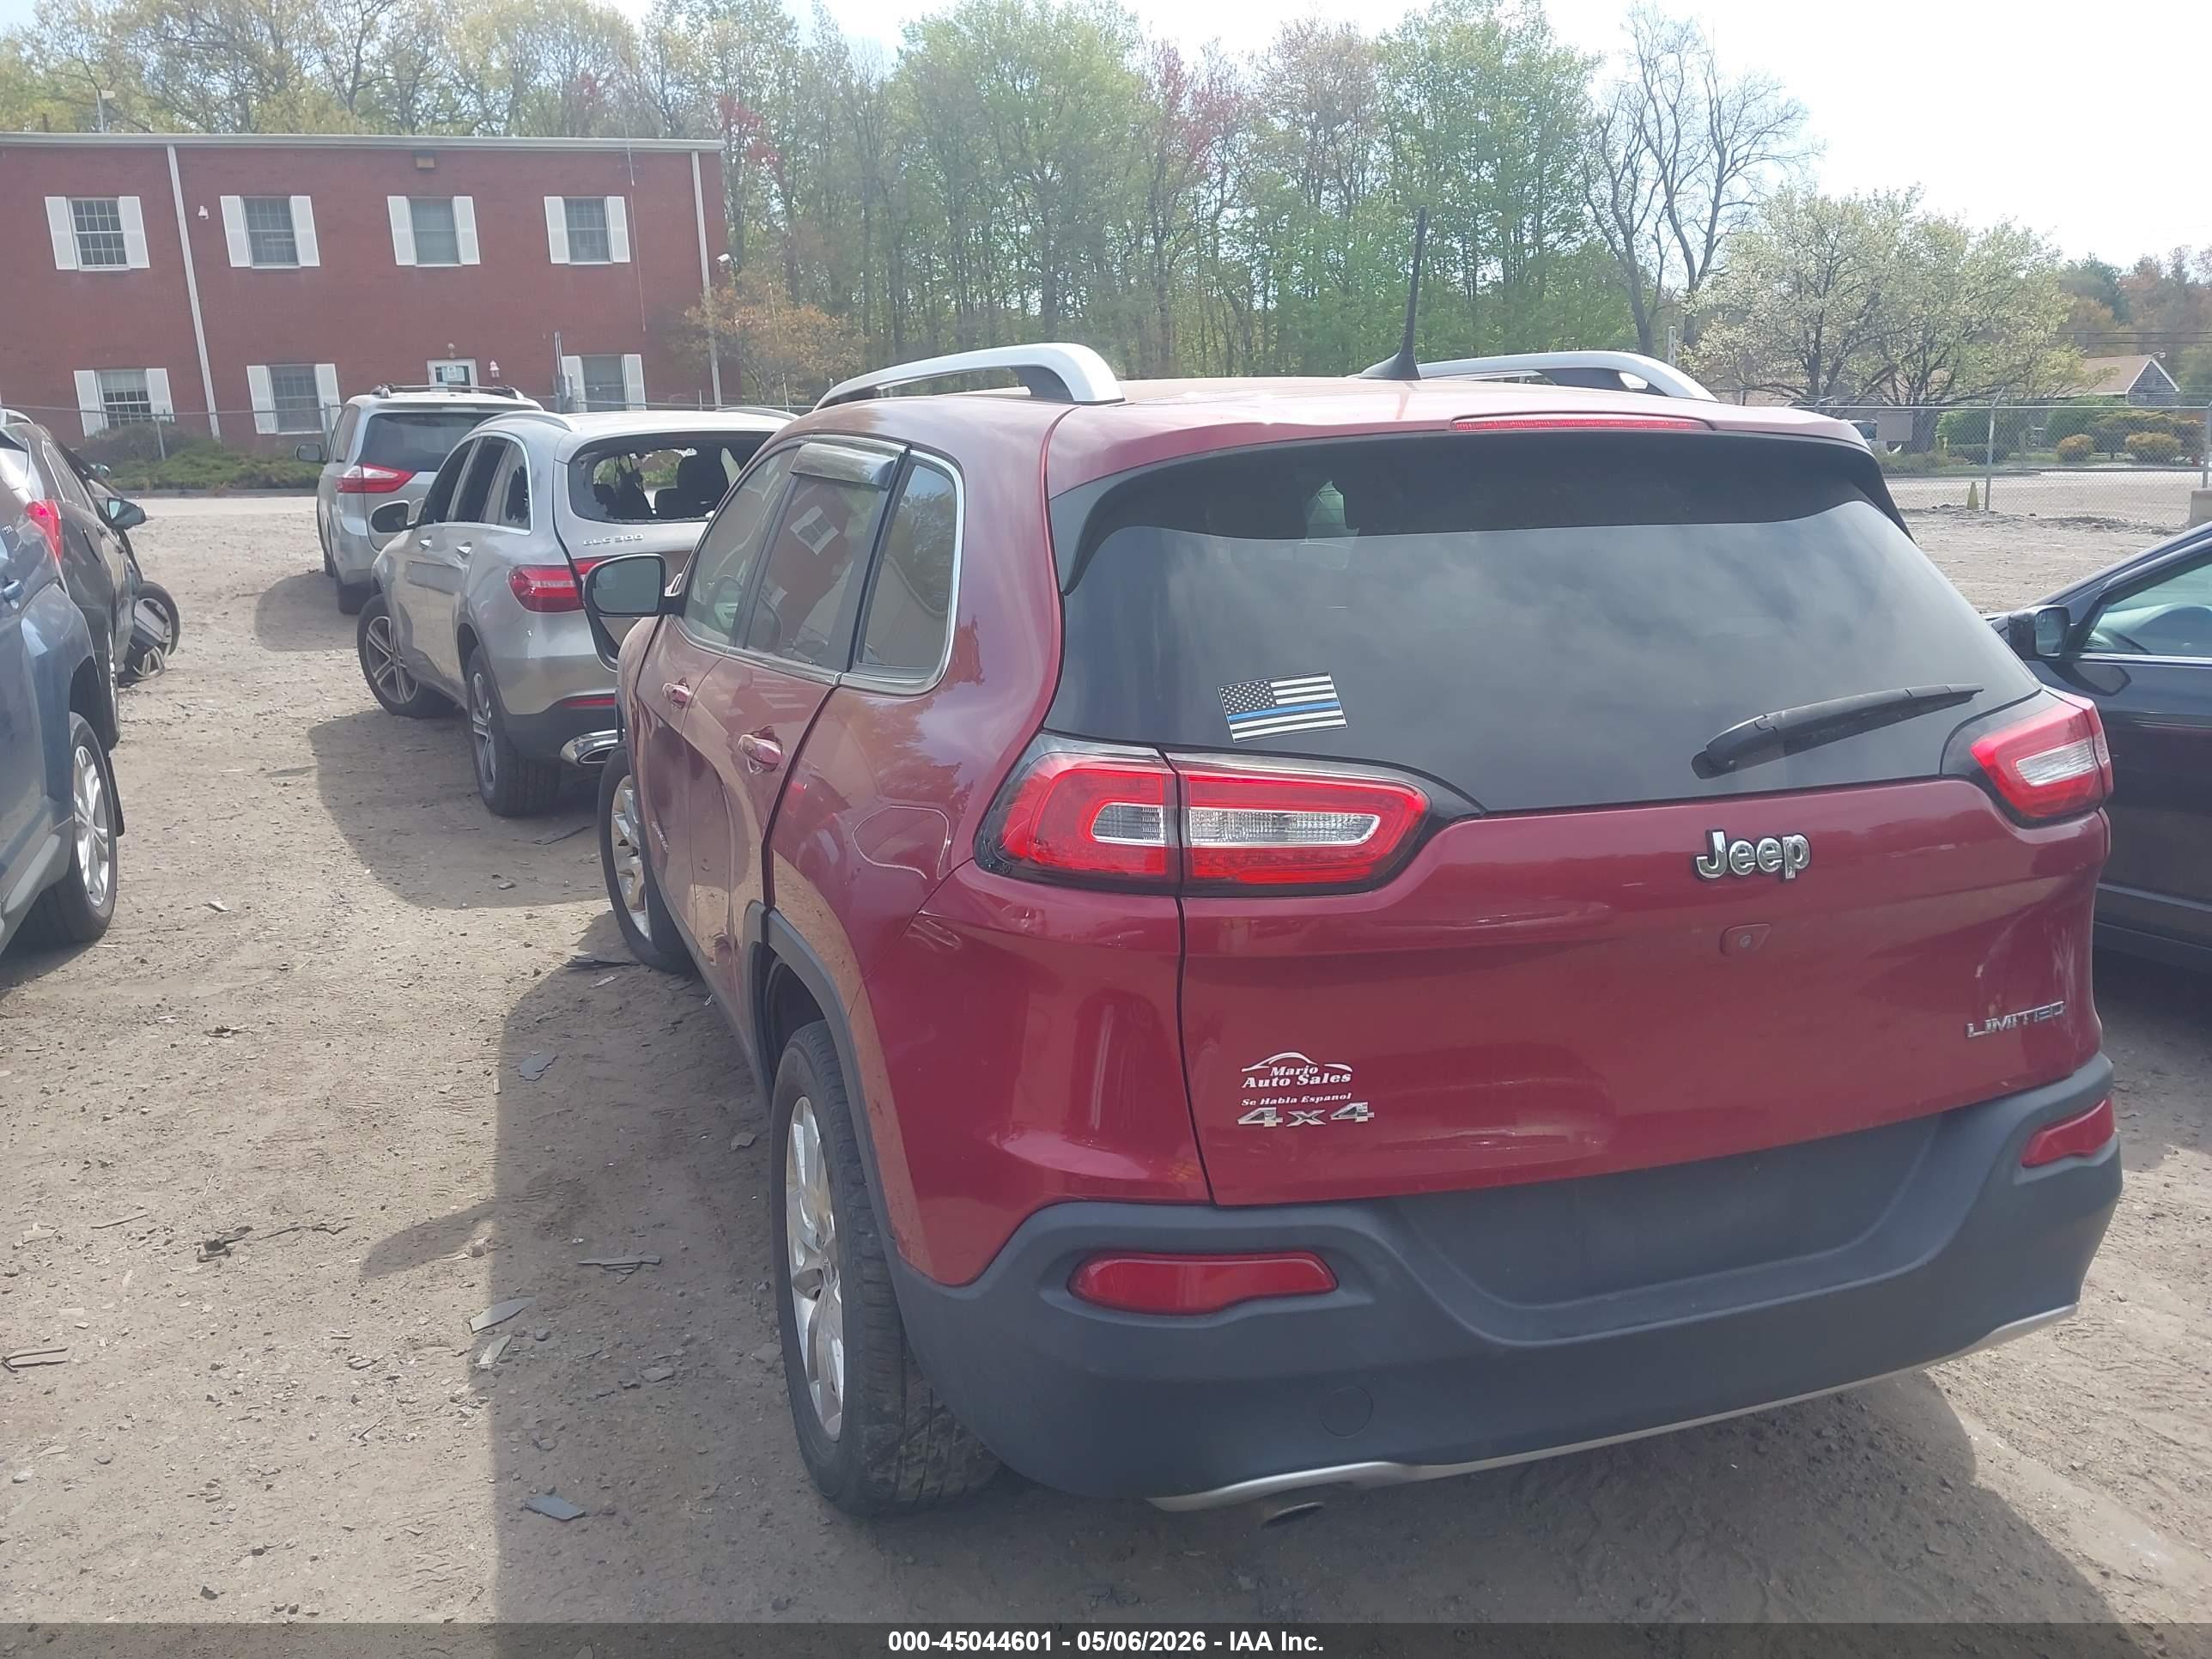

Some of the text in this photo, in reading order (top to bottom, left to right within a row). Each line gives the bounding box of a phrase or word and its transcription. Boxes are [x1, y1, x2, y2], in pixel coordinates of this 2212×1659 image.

[583, 533, 644, 546] GLC 300
[1695, 830, 1812, 880] Jeep
[1966, 1000, 2065, 1038] LIMITED
[1269, 1065, 1319, 1077] Mario
[1241, 1073, 1352, 1089] Auto Sales
[1260, 1097, 1297, 1105] Habla
[1301, 1092, 1352, 1104] Espanol
